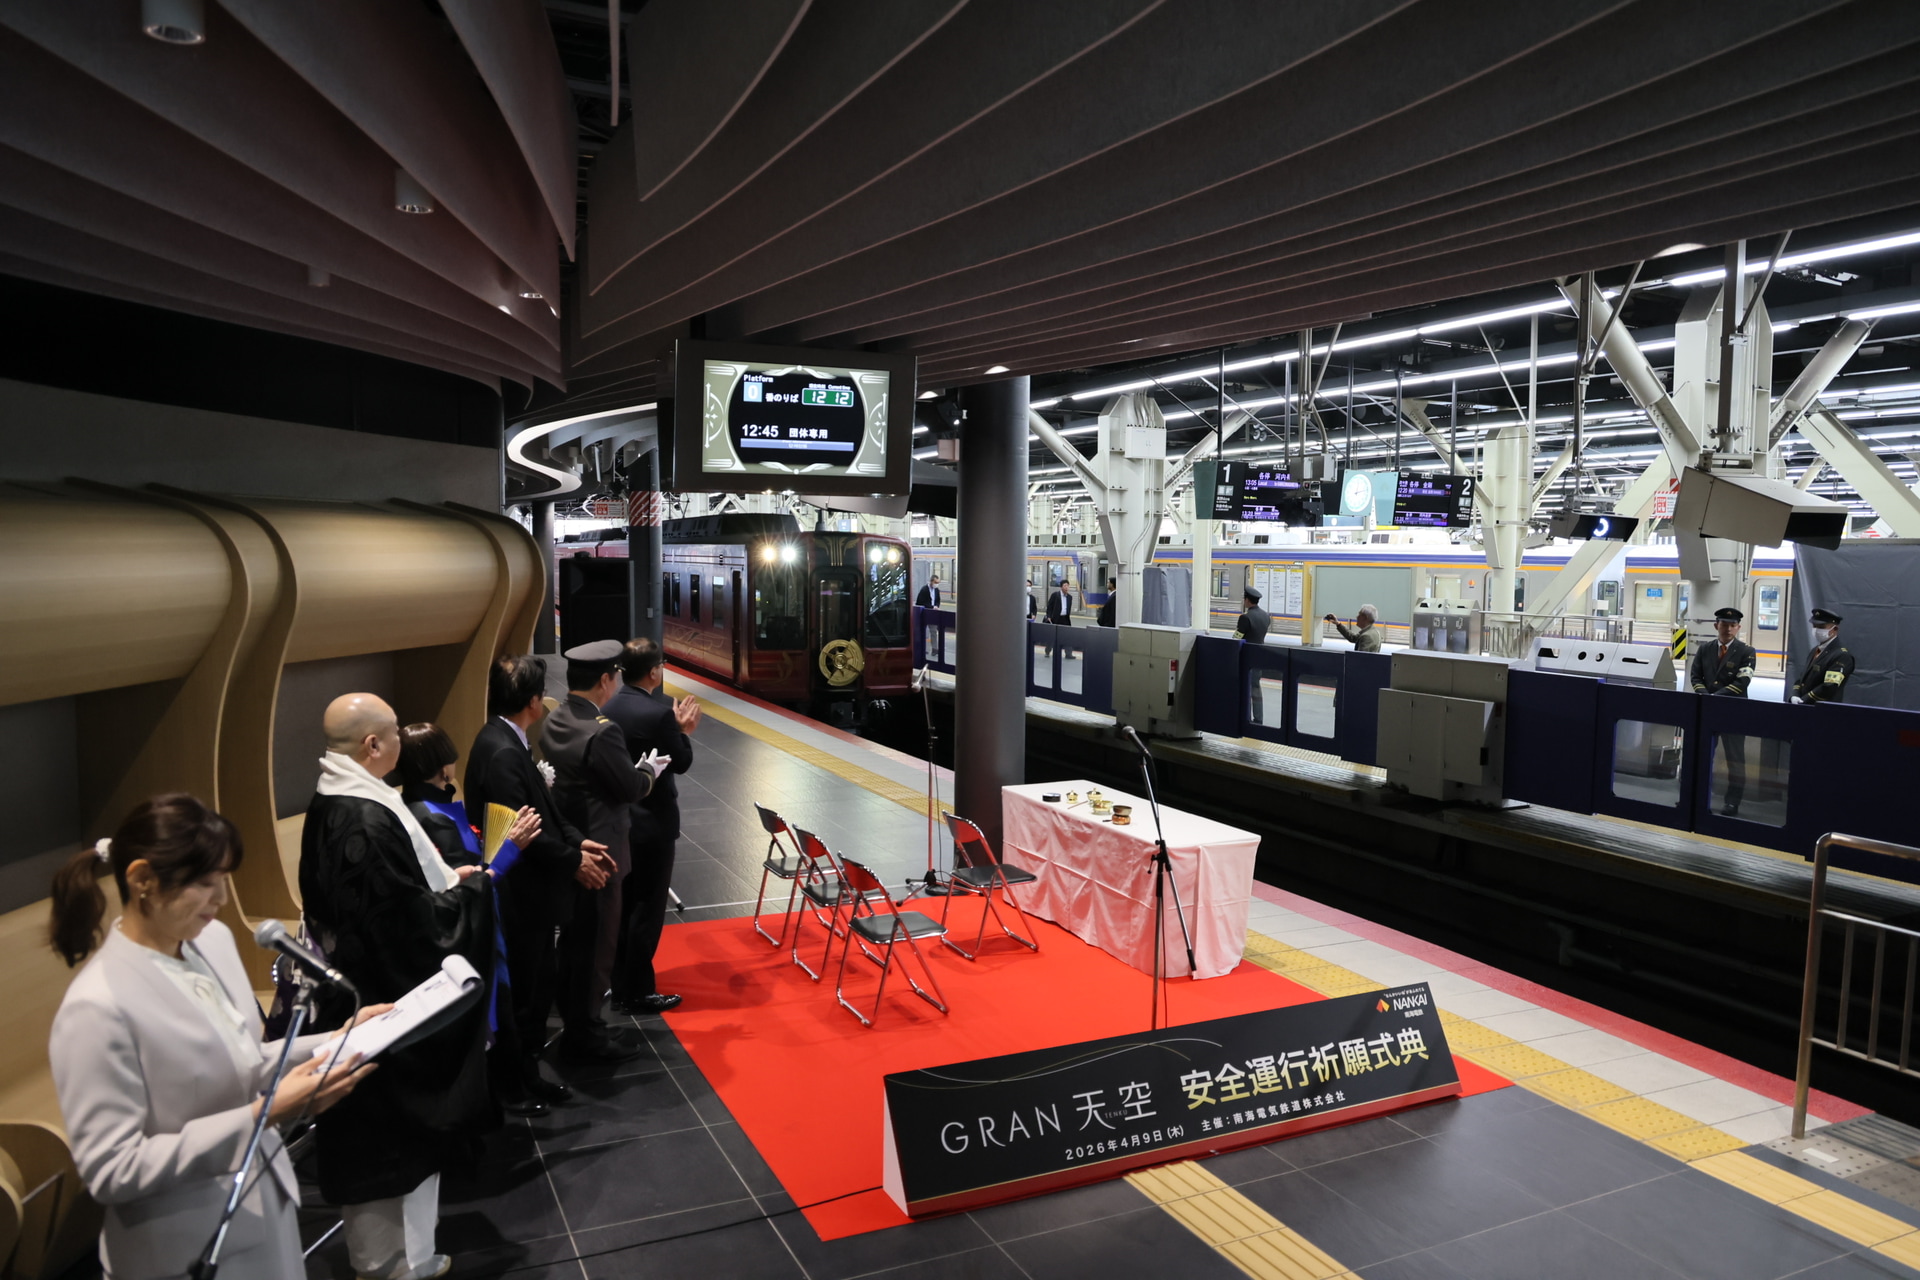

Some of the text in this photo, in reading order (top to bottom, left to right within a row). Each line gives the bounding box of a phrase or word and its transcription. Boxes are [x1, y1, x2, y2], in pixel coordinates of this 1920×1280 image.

[743, 374, 774, 383] Platform
[747, 385, 759, 400] 0
[765, 392, 799, 403] 番のりば
[812, 391, 849, 405] 12 12
[742, 424, 828, 439] 12:45 団体専用
[1223, 463, 1231, 483] 1
[1462, 479, 1471, 495] 2
[1393, 993, 1428, 1011] NANKAI
[1180, 1027, 1429, 1110] 安全運行祈願式典
[941, 1081, 1157, 1154] GRAN 天空
[1104, 1109, 1128, 1119] TENKU
